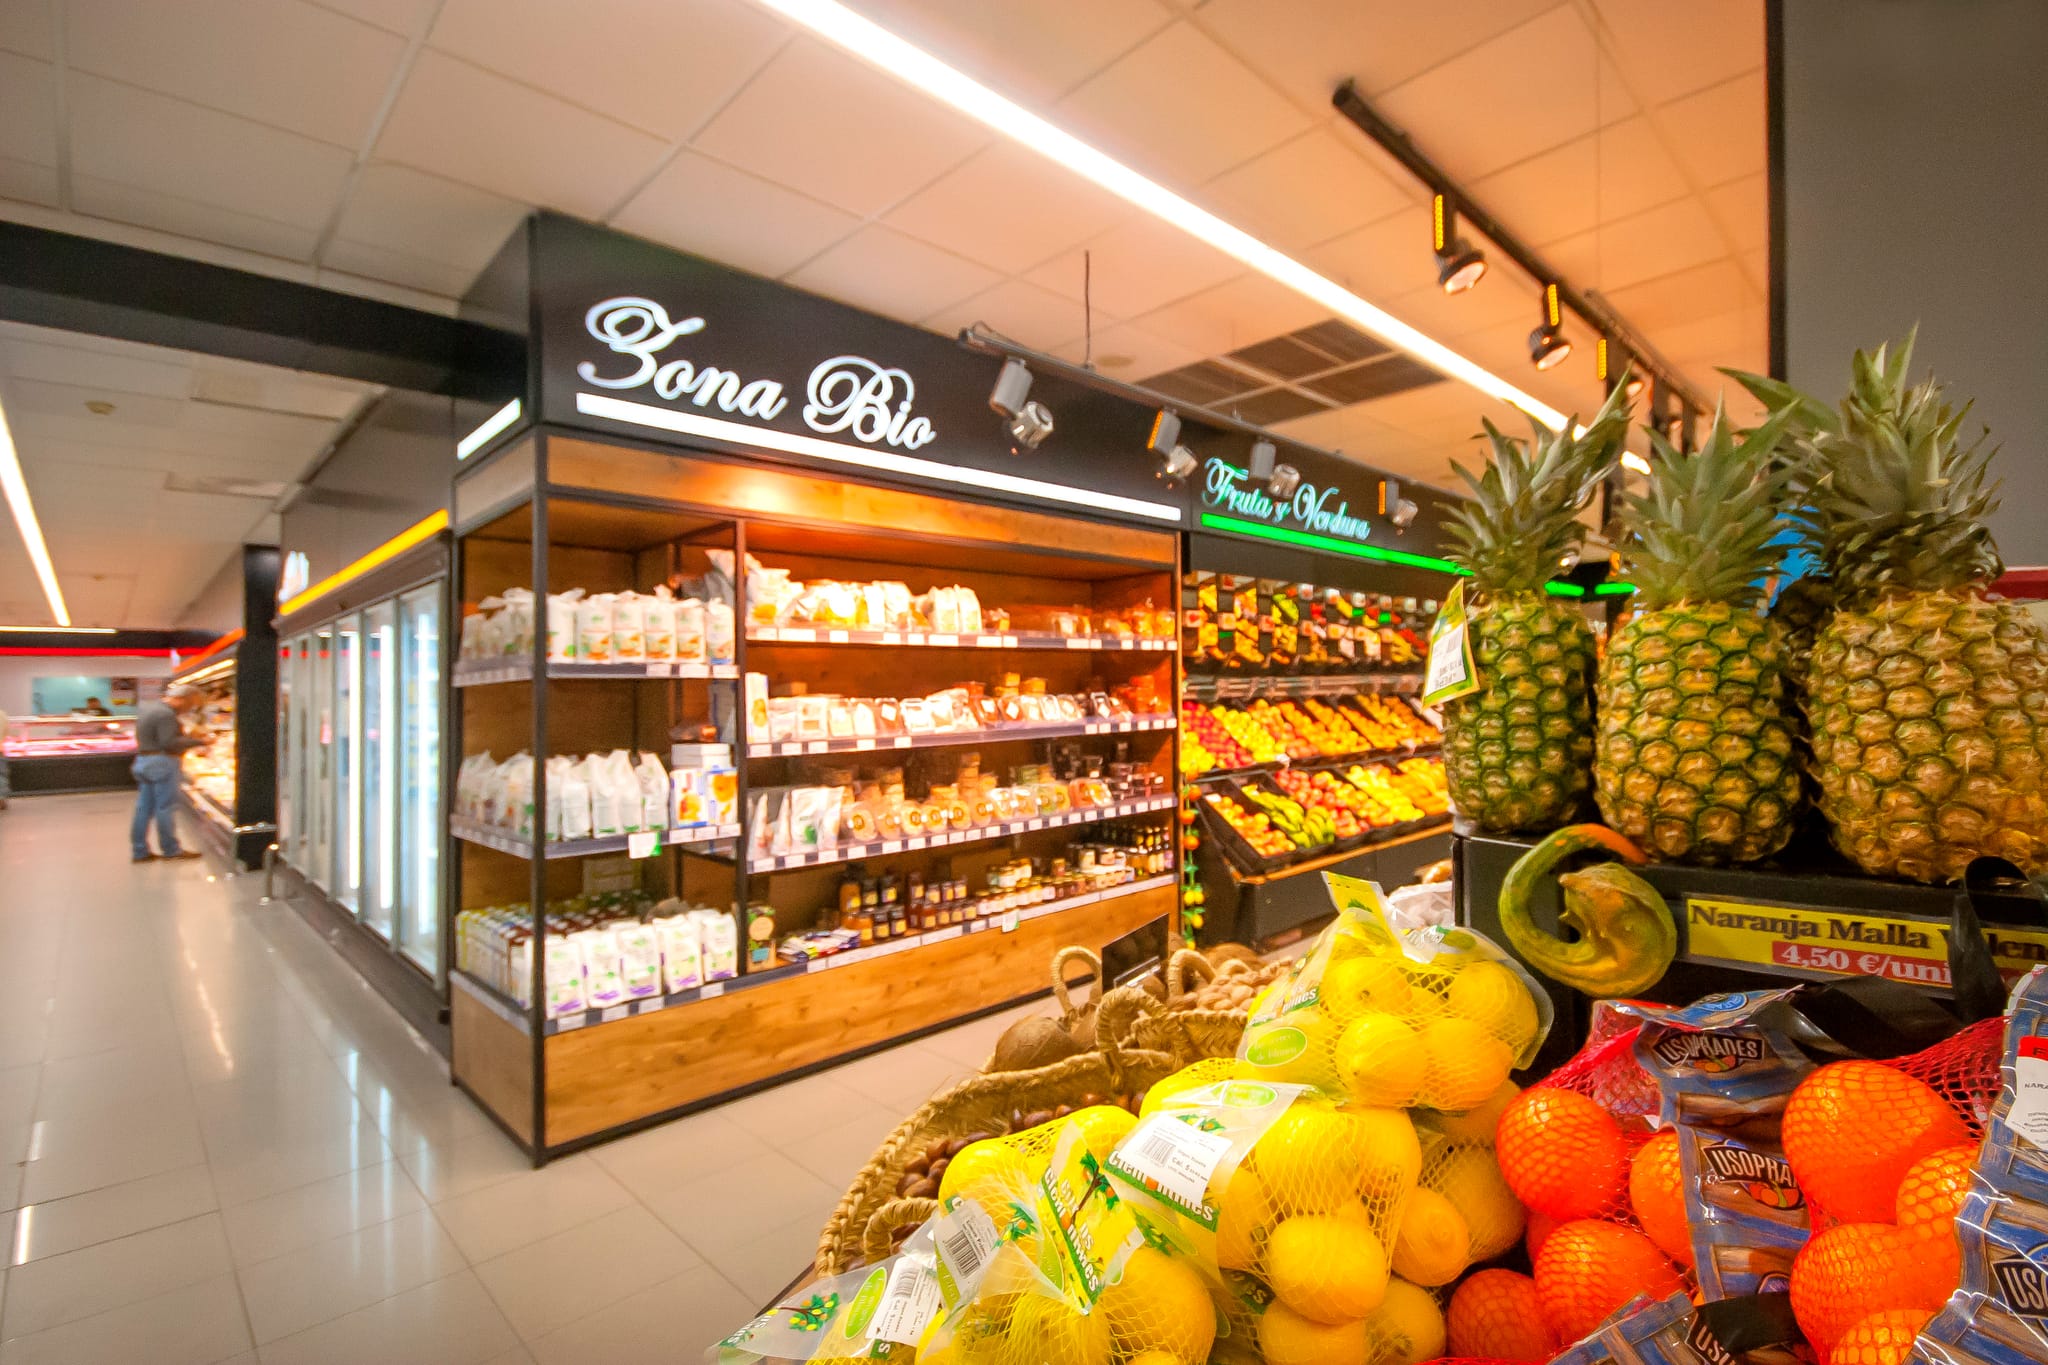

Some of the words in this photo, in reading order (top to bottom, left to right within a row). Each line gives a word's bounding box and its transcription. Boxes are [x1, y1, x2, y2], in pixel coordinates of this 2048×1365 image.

[577, 296, 789, 420] Zona
[803, 355, 937, 450] Bio
[1202, 457, 1273, 519] Fruta
[1272, 500, 1292, 523] y
[1293, 483, 1371, 541] Verdura
[1690, 905, 1821, 940] Naranja
[1827, 918, 1930, 949] Malla
[1782, 945, 1849, 970] 4,50
